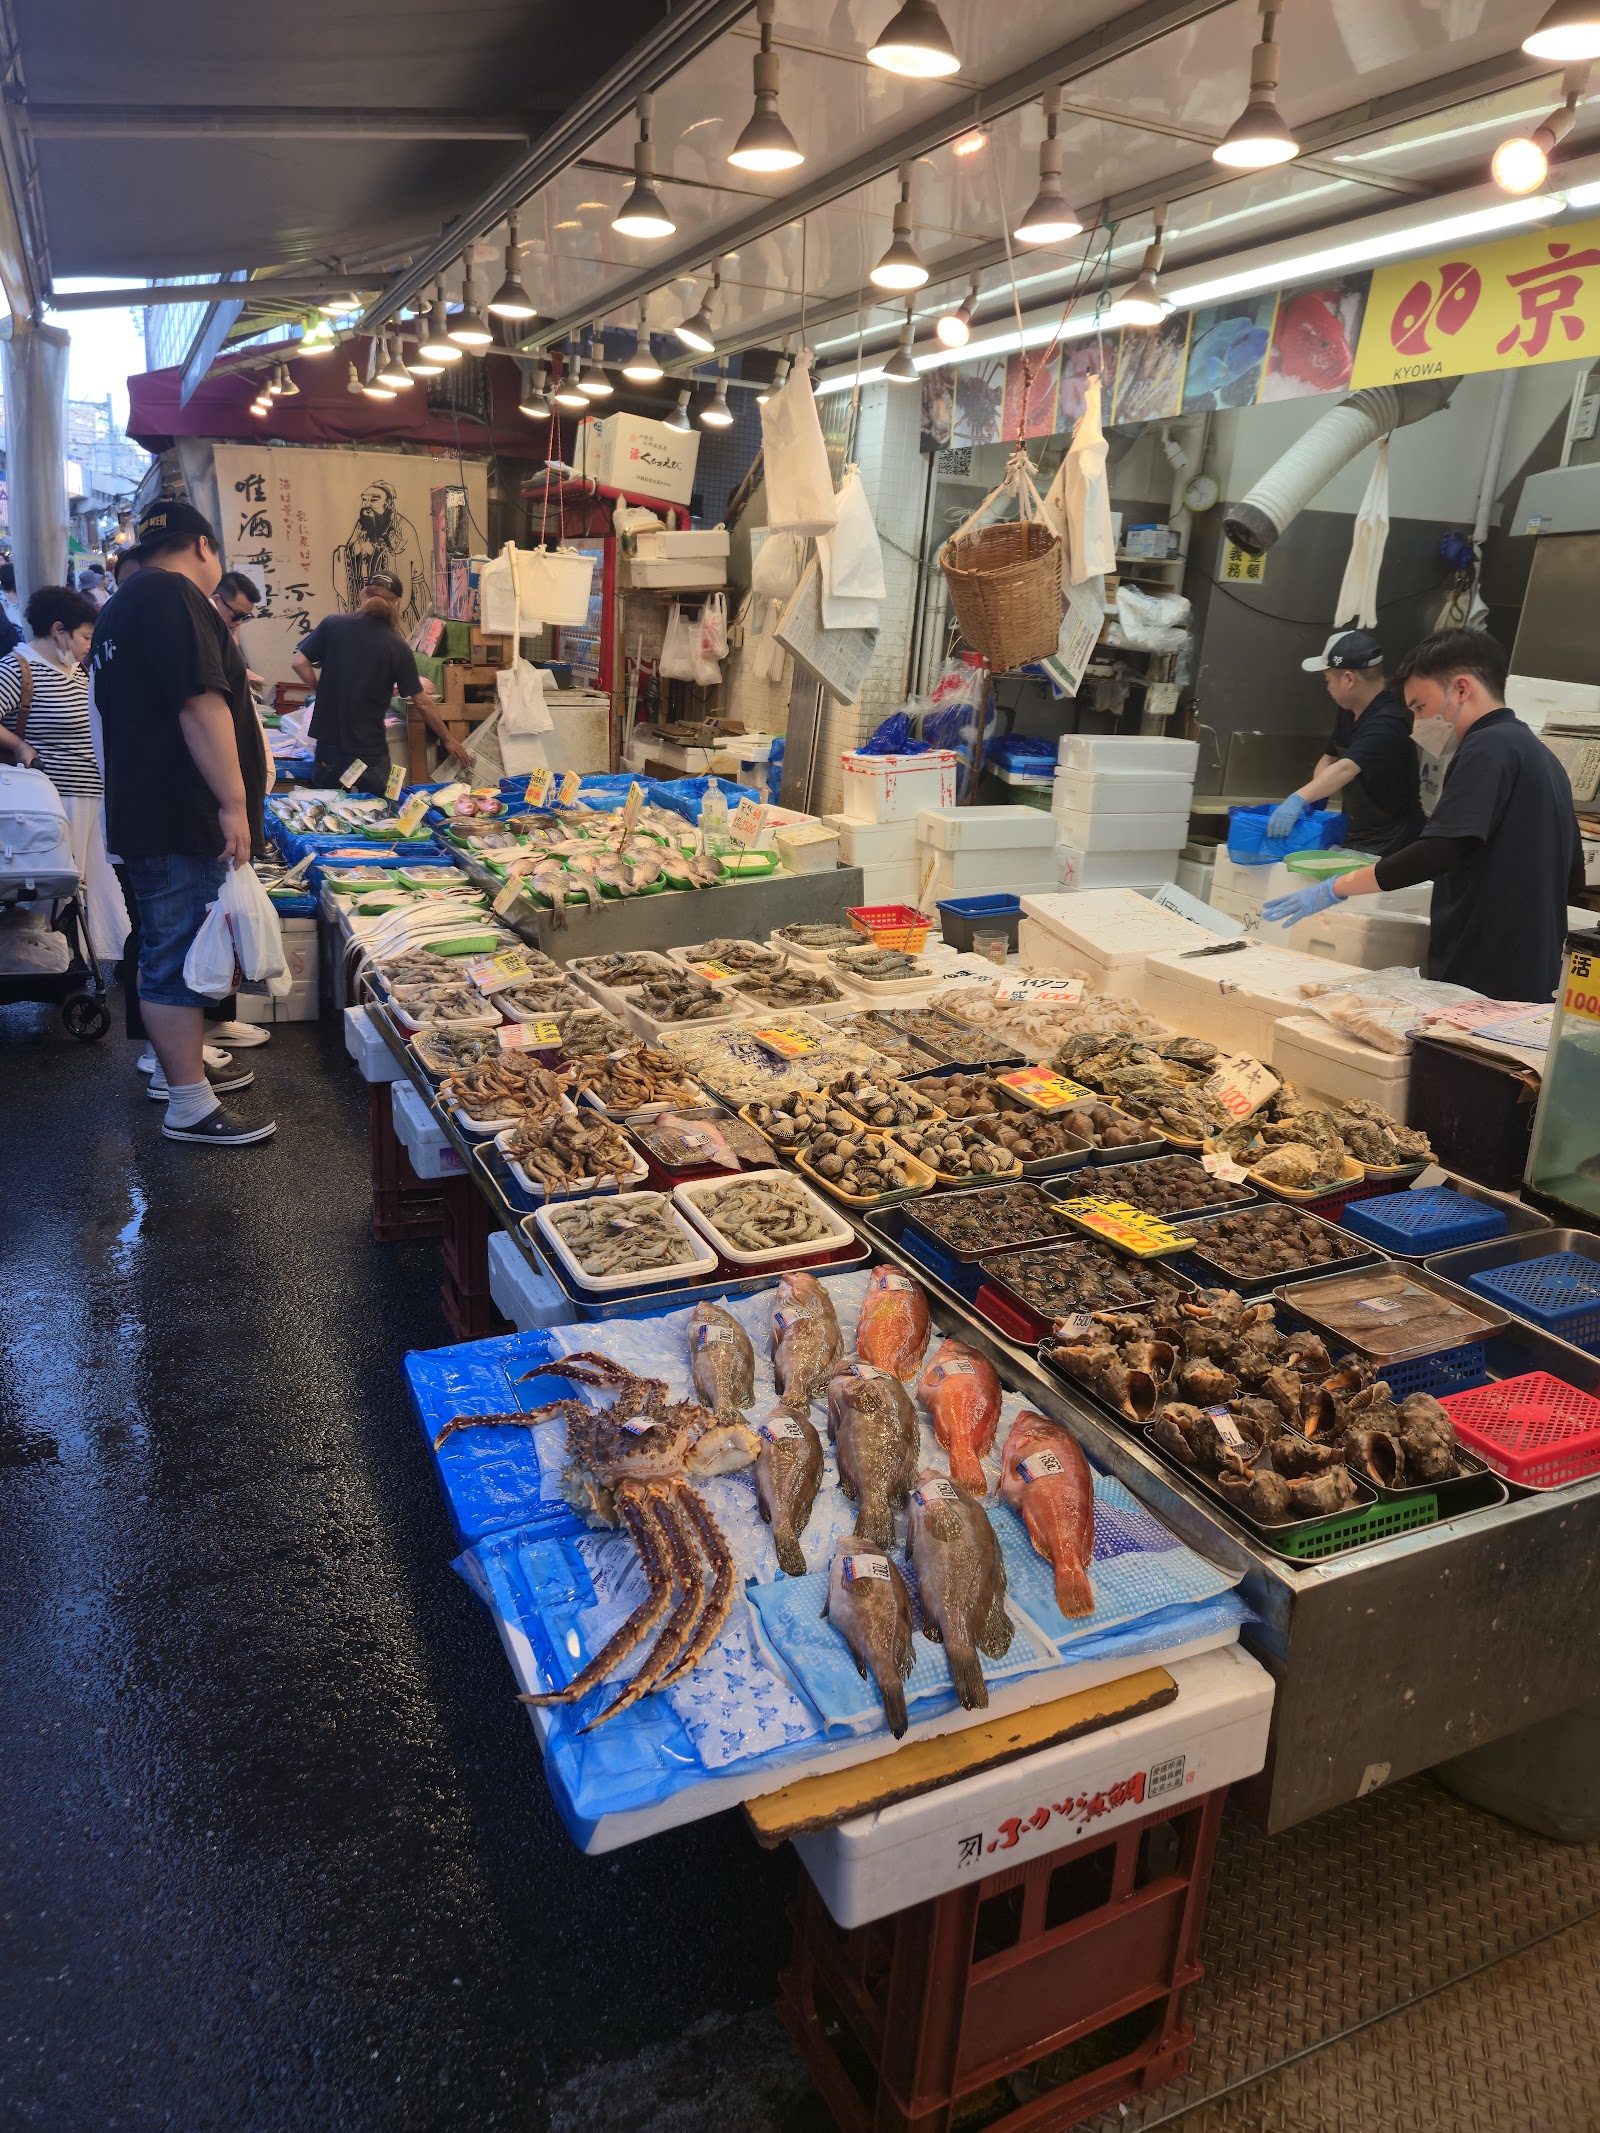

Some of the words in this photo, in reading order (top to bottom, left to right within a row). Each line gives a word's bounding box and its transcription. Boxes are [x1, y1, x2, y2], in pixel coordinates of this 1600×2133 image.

[1496, 243, 1600, 358] 京
[1393, 361, 1443, 380] KYOWA
[1570, 954, 1592, 978] 活
[1034, 991, 1080, 1001] 1000
[1564, 988, 1600, 1015] 100
[1051, 1078, 1092, 1098] つぶ貝
[1218, 1084, 1253, 1115] 1000
[1072, 1314, 1092, 1327] 1500
[775, 1604, 795, 1629] ICE
